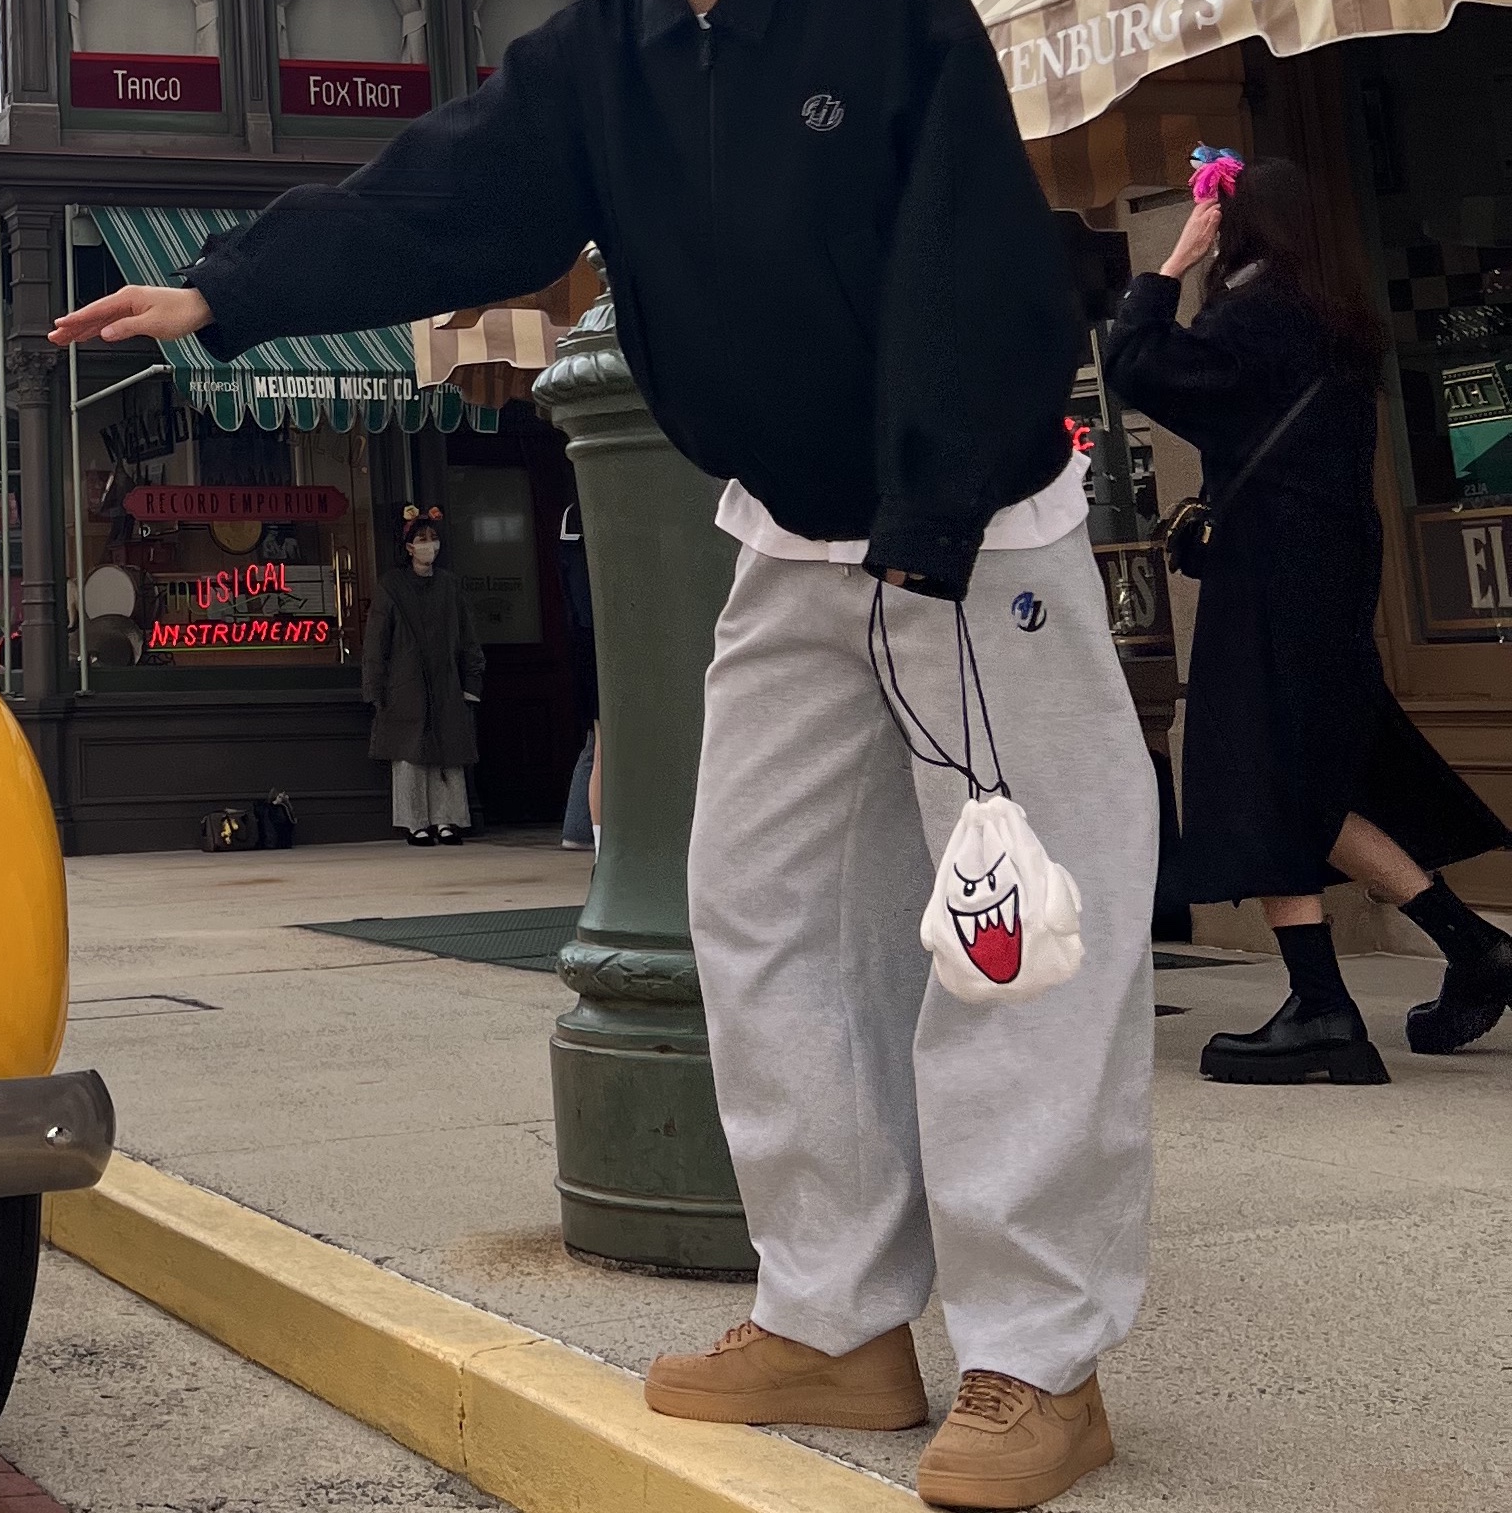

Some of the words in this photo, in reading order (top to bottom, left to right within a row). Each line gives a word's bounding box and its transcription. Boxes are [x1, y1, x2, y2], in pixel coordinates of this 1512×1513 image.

[189, 381, 240, 394] RECORDS
[254, 375, 337, 399] MELODEON
[340, 376, 388, 400] MUSIC
[394, 377, 420, 401] CO.
[145, 491, 220, 514] RECORD
[229, 492, 330, 515] EMPORIUM
[148, 619, 329, 648] INSTRUMENTS
